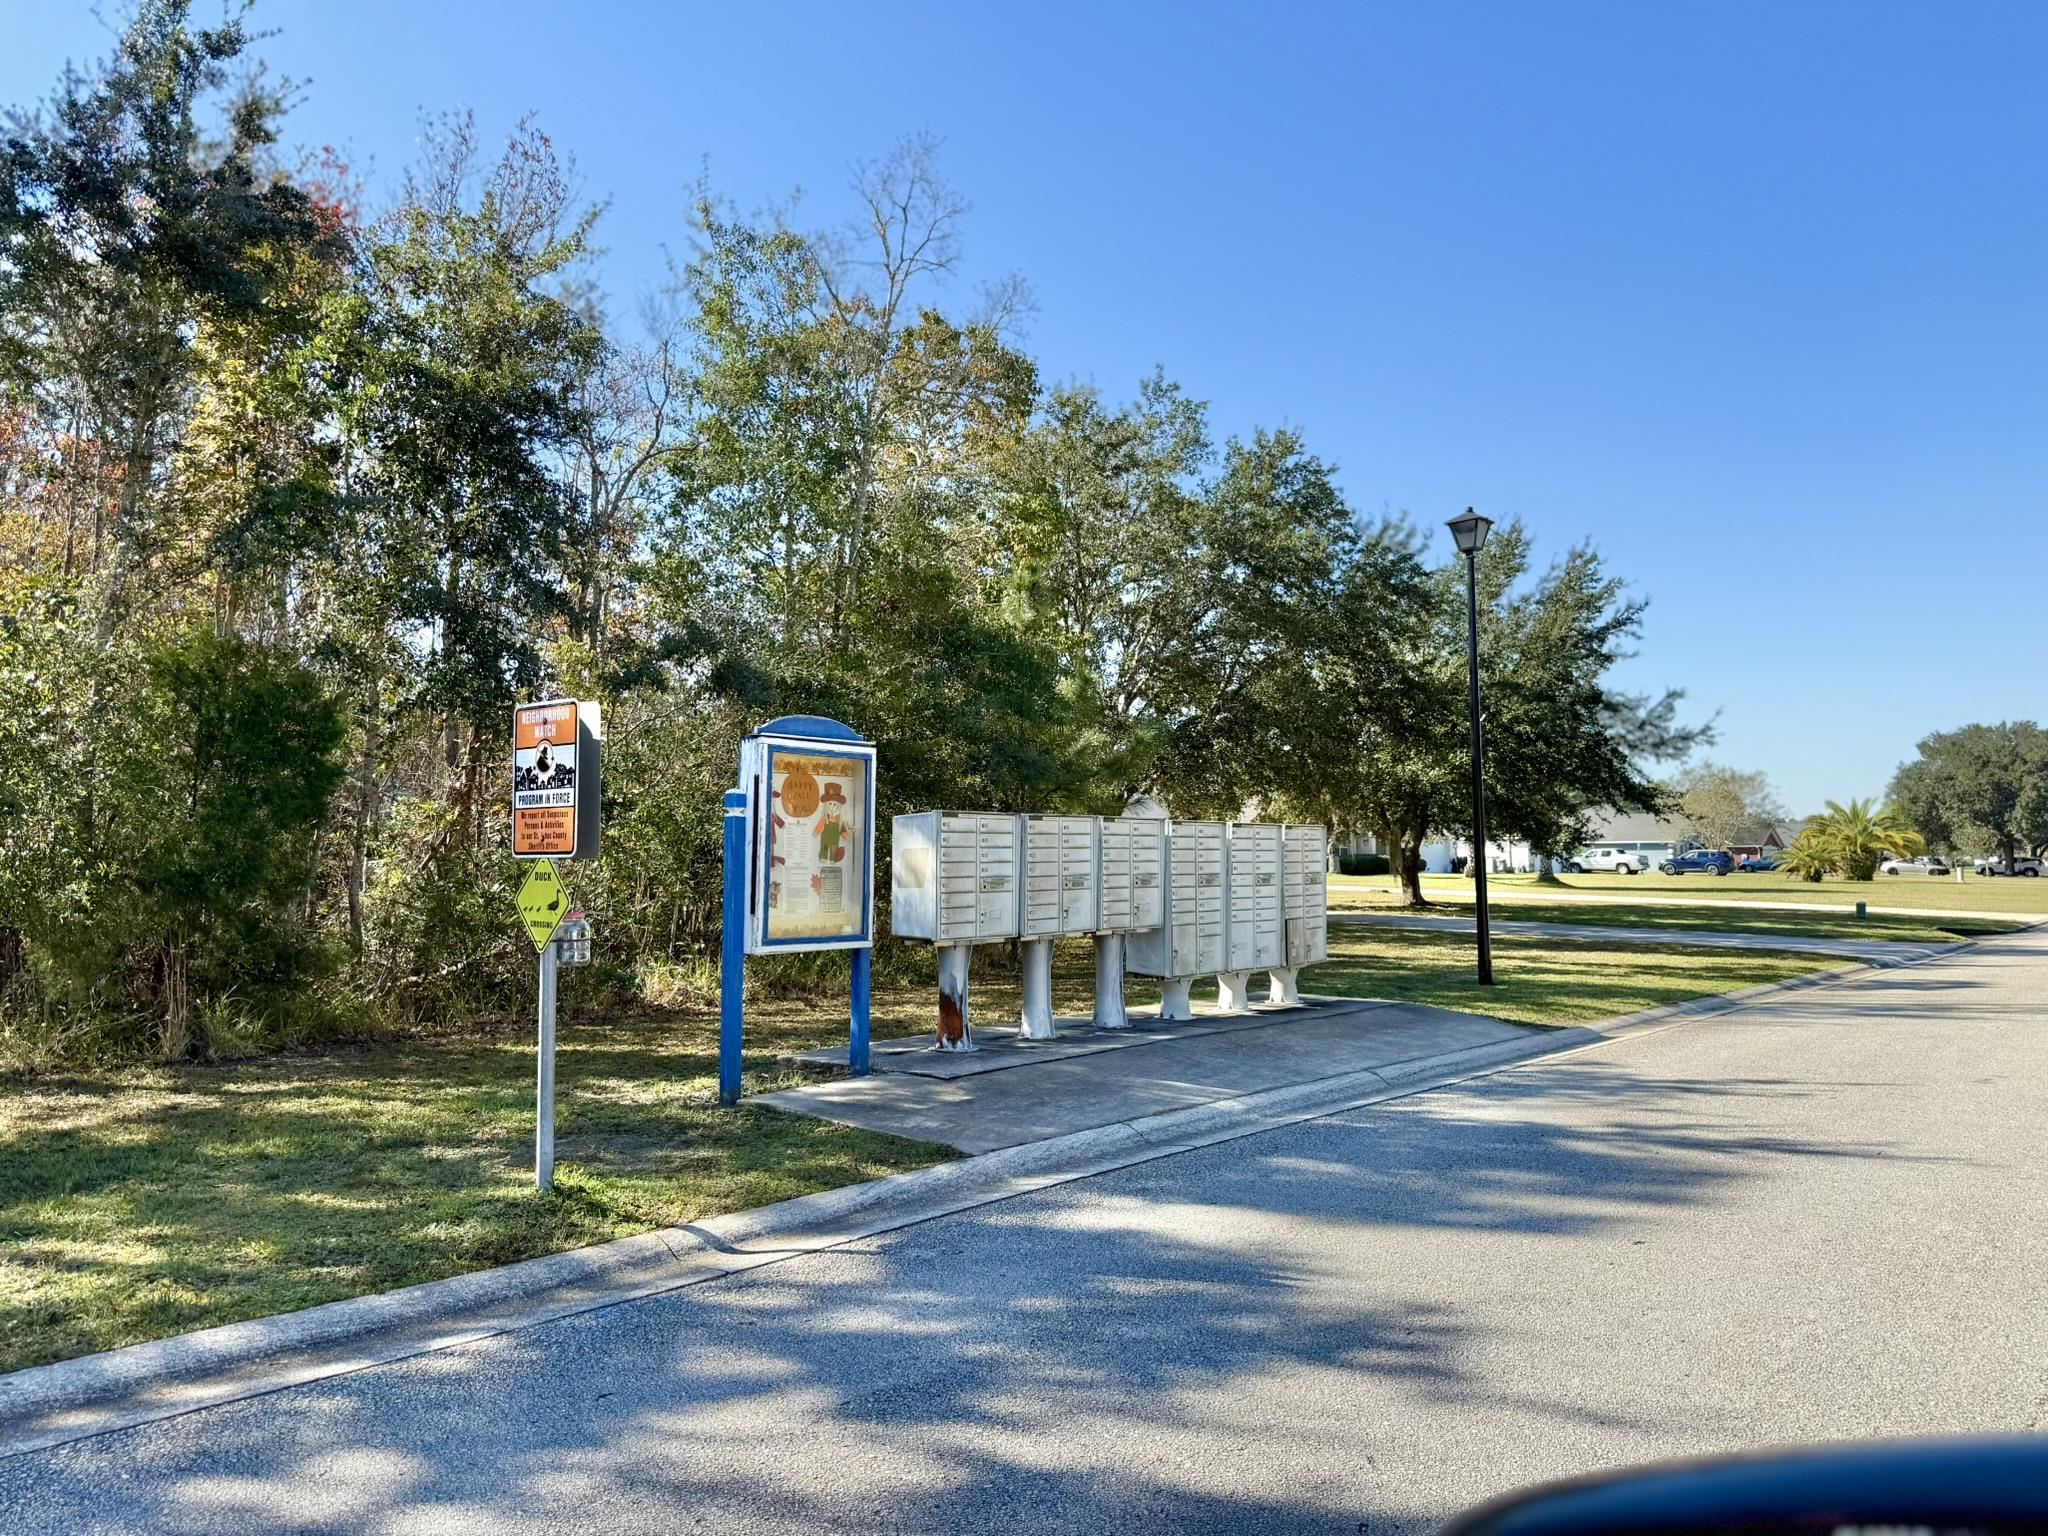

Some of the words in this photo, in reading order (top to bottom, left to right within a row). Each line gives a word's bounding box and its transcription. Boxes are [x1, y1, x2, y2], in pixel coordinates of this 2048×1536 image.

[522, 707, 570, 724] NEIGHBORHOOD
[534, 724, 556, 738] WATCH
[519, 795, 543, 805] PROGRAM
[545, 794, 550, 804] IN
[553, 793, 570, 804] FORCE
[528, 811, 540, 820] report
[547, 811, 568, 819] Suspicious
[553, 831, 567, 841] County
[534, 871, 552, 881] DUCK
[530, 920, 553, 929] CROSSING
